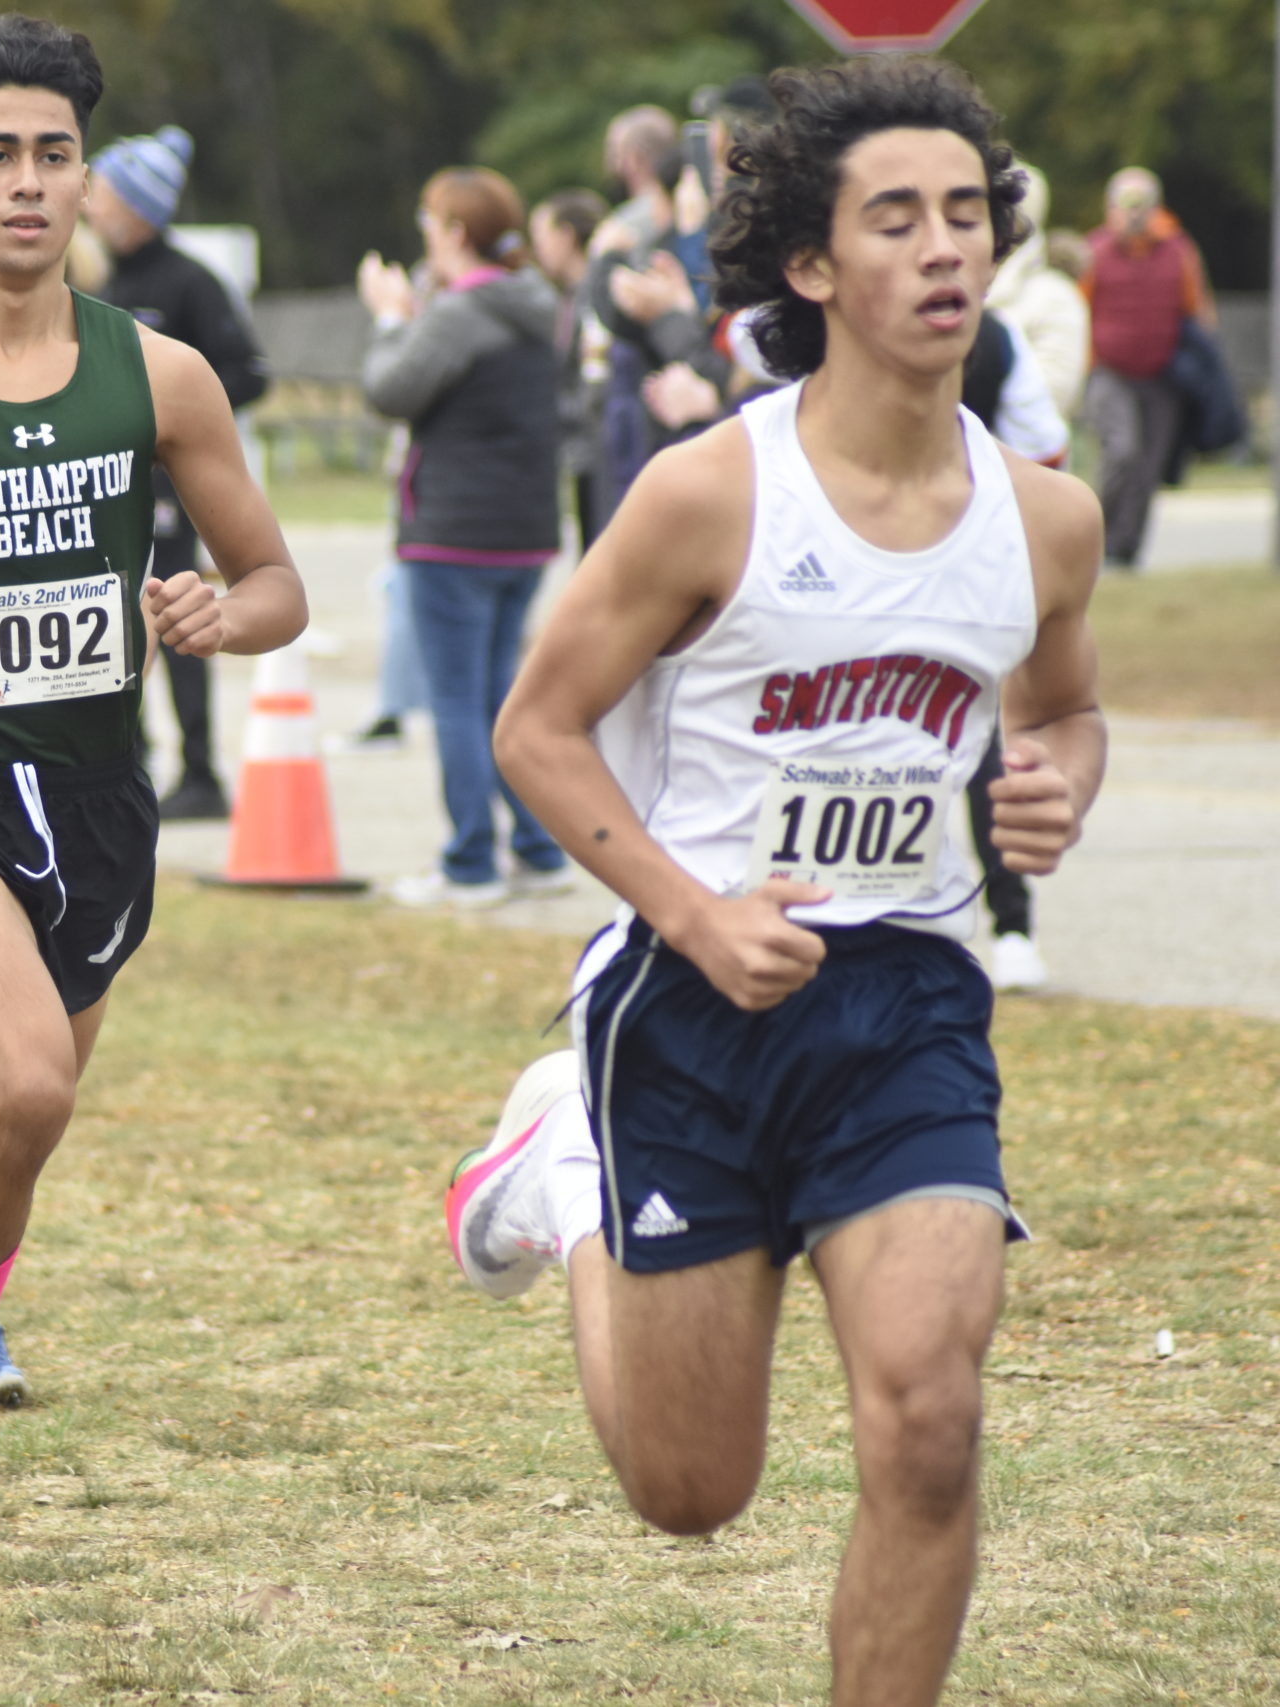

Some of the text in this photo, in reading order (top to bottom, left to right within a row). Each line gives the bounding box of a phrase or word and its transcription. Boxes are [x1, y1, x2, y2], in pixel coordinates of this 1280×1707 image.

[34, 586, 65, 605] 2nd
[70, 581, 109, 600] Wind
[779, 577, 837, 593] adidas
[781, 764, 945, 786] Schwab's 2nd Wind
[771, 795, 934, 866] 1002
